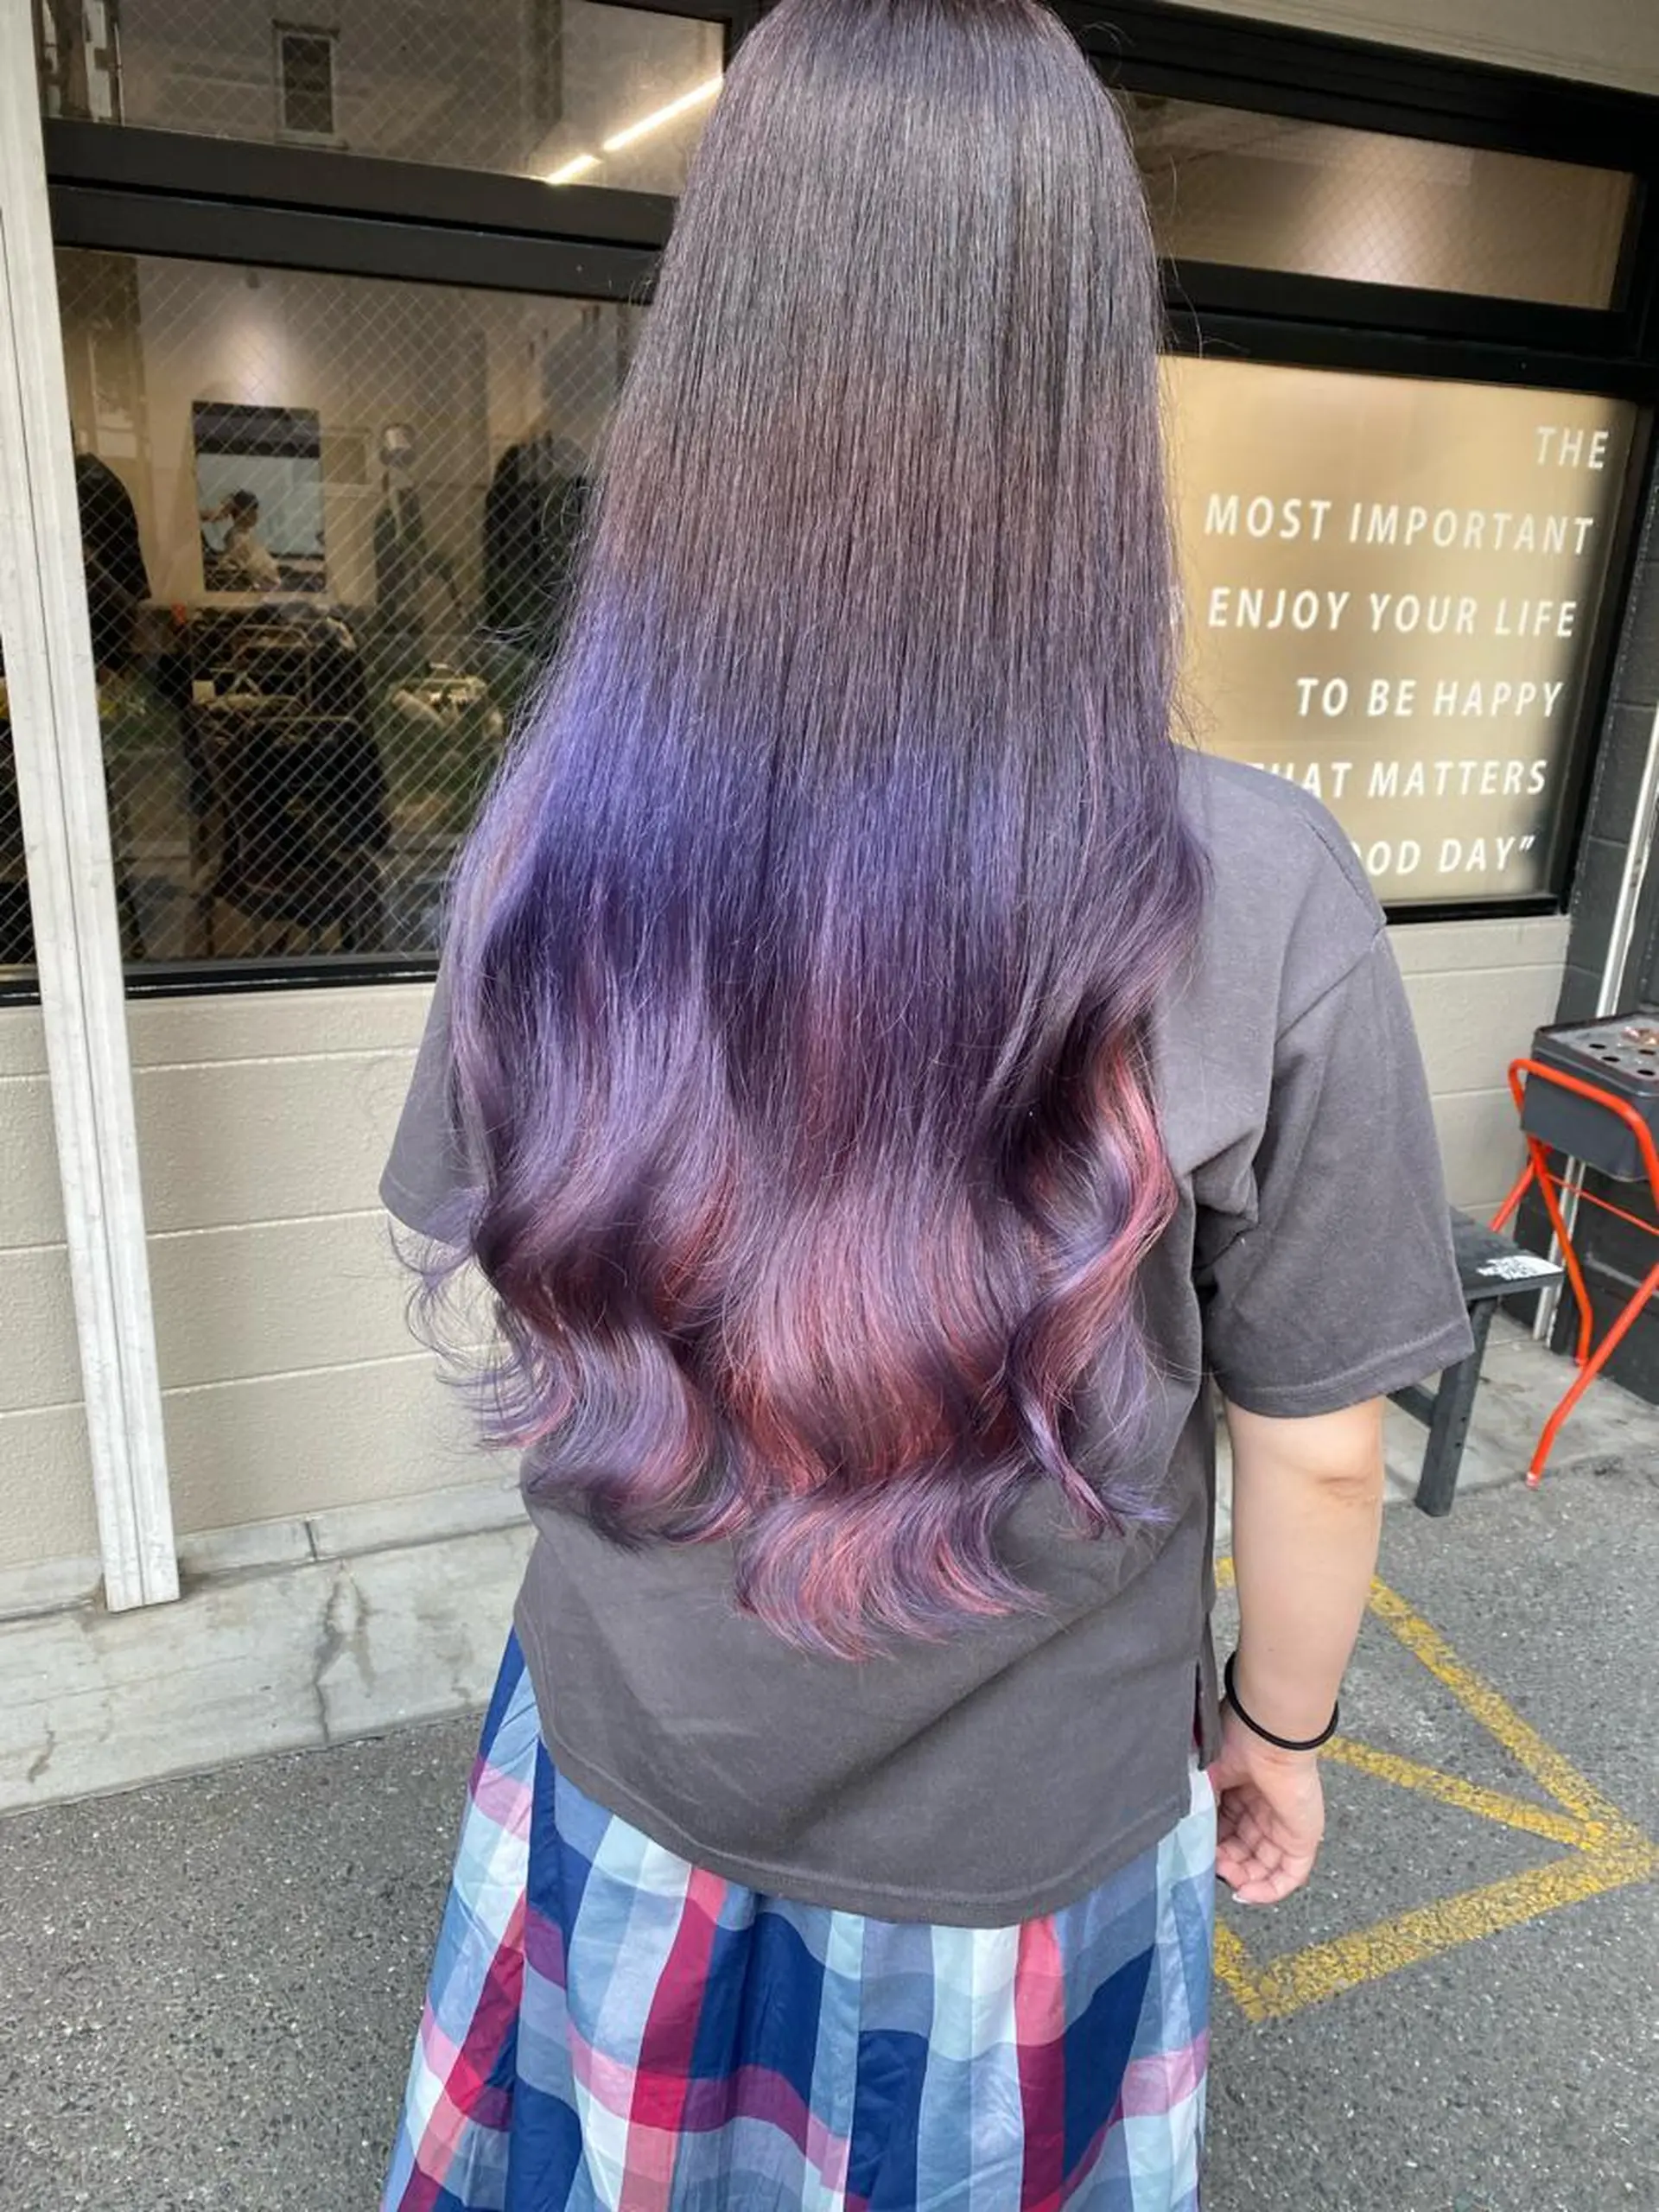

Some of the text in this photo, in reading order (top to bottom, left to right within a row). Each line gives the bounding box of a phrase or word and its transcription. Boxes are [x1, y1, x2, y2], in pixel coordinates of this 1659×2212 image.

[1537, 427, 1609, 470] THE
[1205, 493, 1593, 555] MOST IMPORTANT
[1209, 587, 1350, 630] ENJOY
[1370, 593, 1478, 635] YOUR
[1494, 599, 1577, 638] LIFE
[1297, 677, 1564, 717] TO BE HAPPY
[1246, 760, 1548, 799] AT MATTERS
